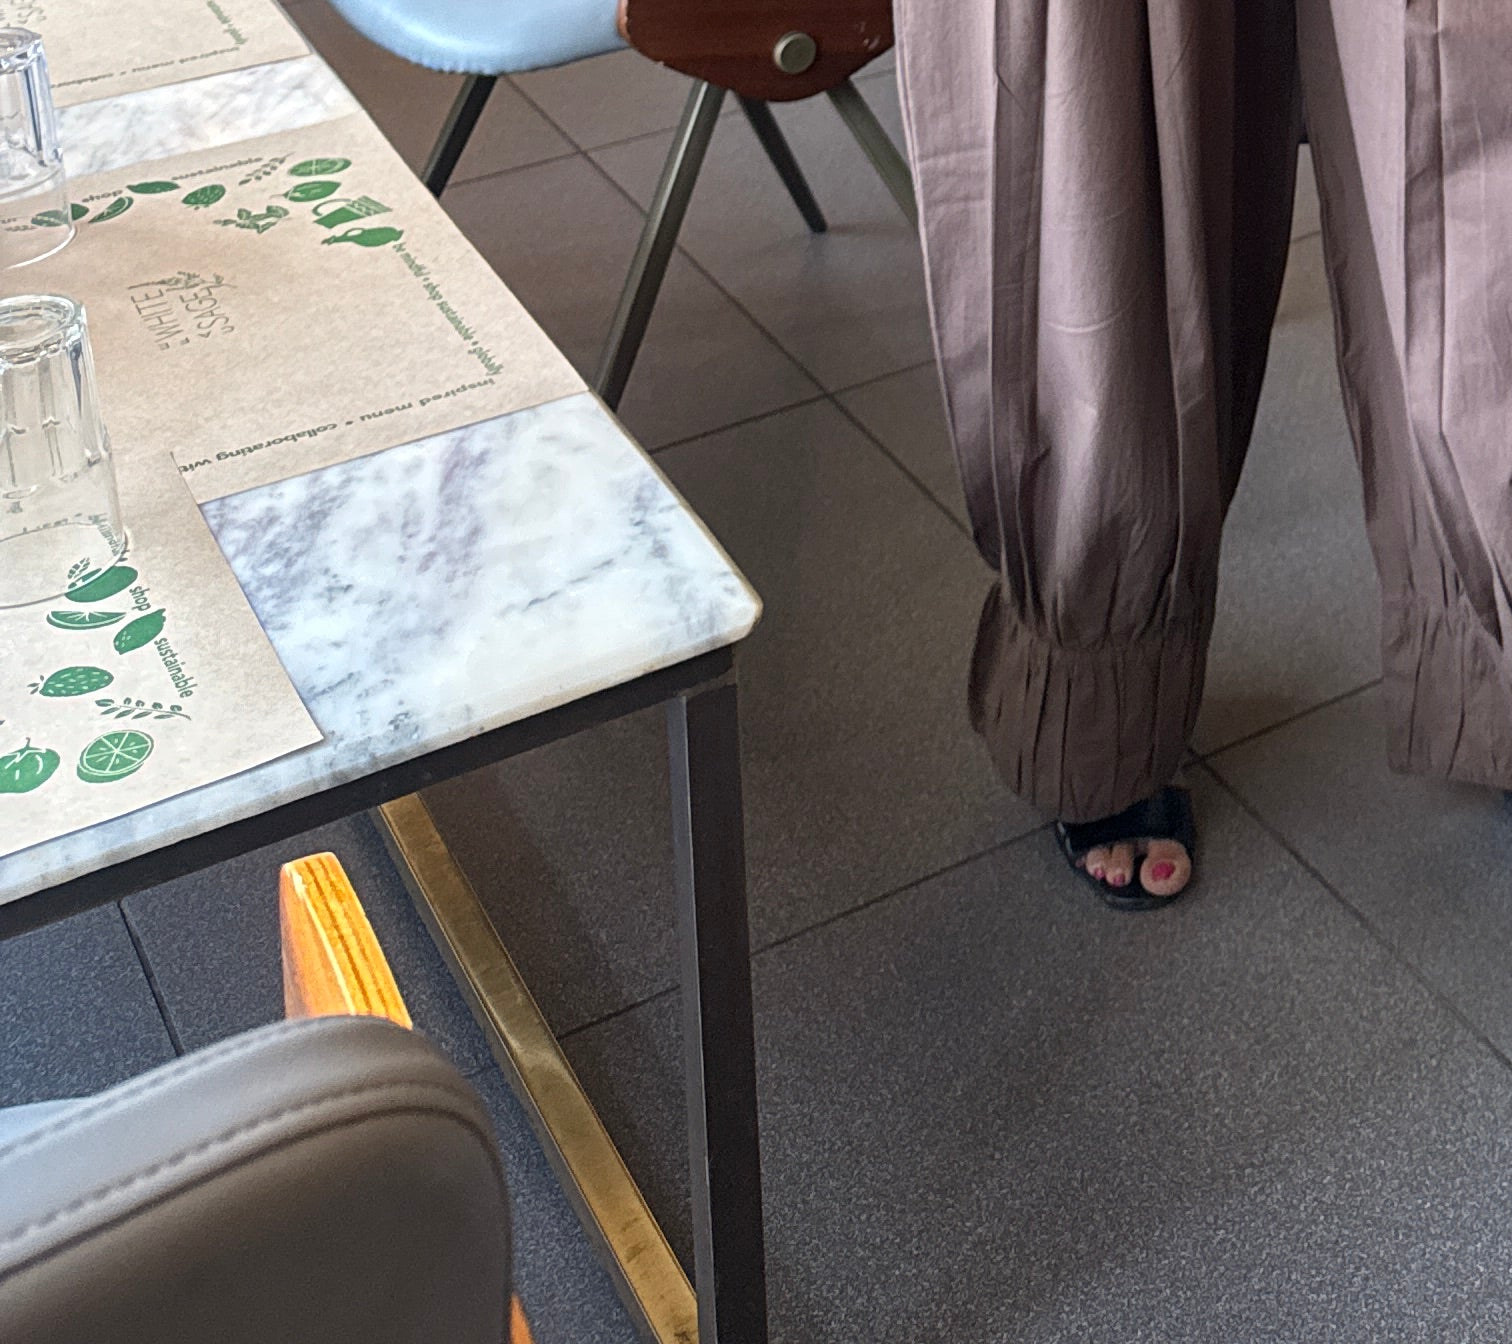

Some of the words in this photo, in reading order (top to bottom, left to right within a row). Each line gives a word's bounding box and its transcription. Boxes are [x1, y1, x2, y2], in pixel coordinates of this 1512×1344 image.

[172, 156, 264, 181] sustainable
[82, 189, 123, 203] shop
[130, 288, 184, 344] WHITE
[180, 286, 229, 339] SAGE
[418, 377, 496, 407] inspired
[359, 402, 414, 422] menu
[215, 422, 338, 463] collaborating
[177, 459, 212, 474] wit
[129, 584, 152, 612] shop
[154, 637, 198, 699] sustainable
